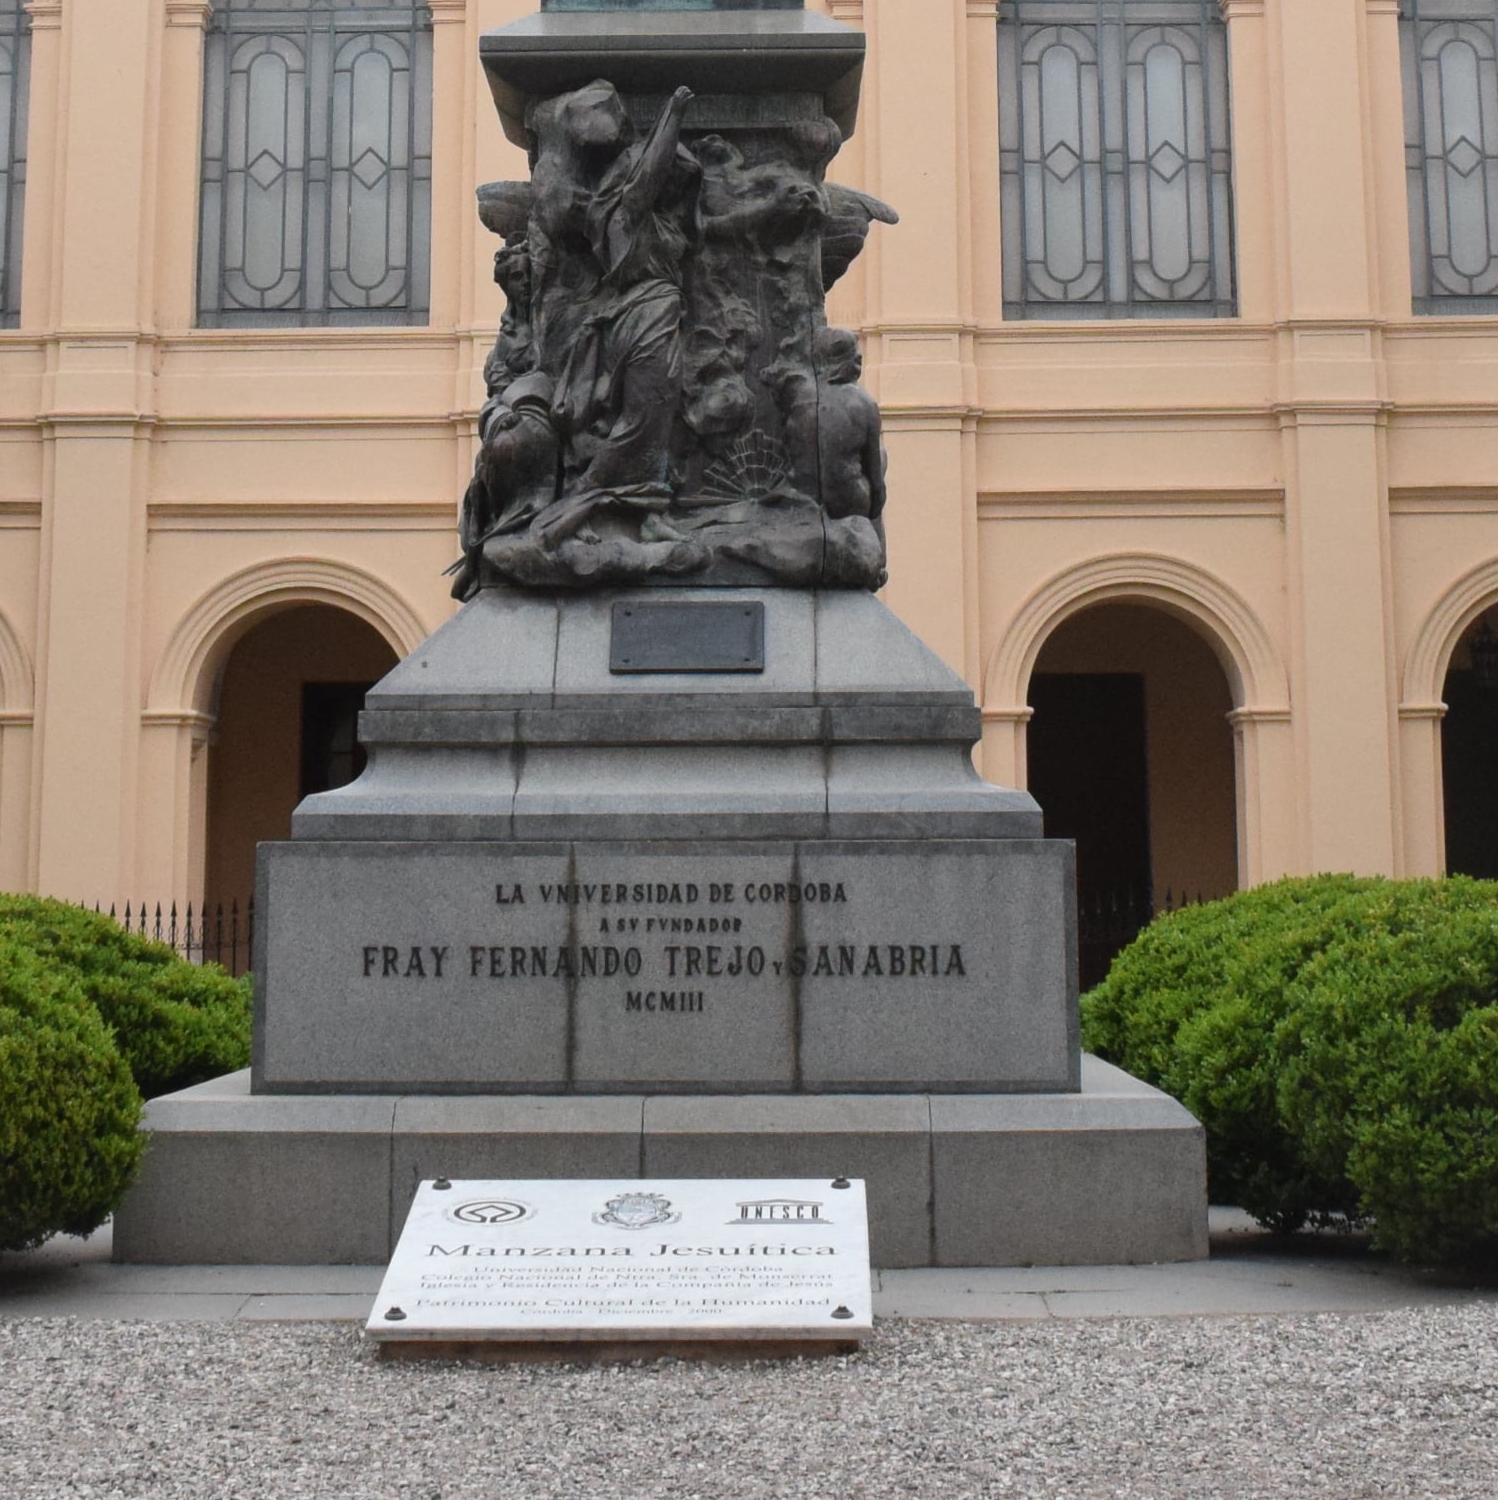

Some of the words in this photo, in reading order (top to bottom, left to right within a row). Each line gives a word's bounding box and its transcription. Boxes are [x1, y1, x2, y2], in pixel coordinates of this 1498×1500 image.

[495, 884, 526, 904] LA
[539, 883, 700, 904] VNIVERSIDAD
[708, 882, 734, 903] DE
[744, 882, 847, 903] CORDOBA
[599, 917, 610, 932] A
[616, 917, 639, 932] SV
[645, 917, 742, 932] FVNDADOR
[362, 946, 450, 977] FRAY
[469, 946, 643, 977] FERNANDO
[663, 946, 766, 977] TREJO
[789, 944, 967, 977] SANABRIA
[625, 991, 704, 1012] MCMIII
[740, 1205, 820, 1219] UNESCO
[426, 1244, 633, 1257] Manzana
[649, 1243, 839, 1257] Jesuítica
[417, 1299, 538, 1307] Patrimonio
[545, 1298, 633, 1306] Cultural
[641, 1298, 666, 1306] de
[675, 1298, 691, 1306] la
[702, 1297, 830, 1305] Humanidad
